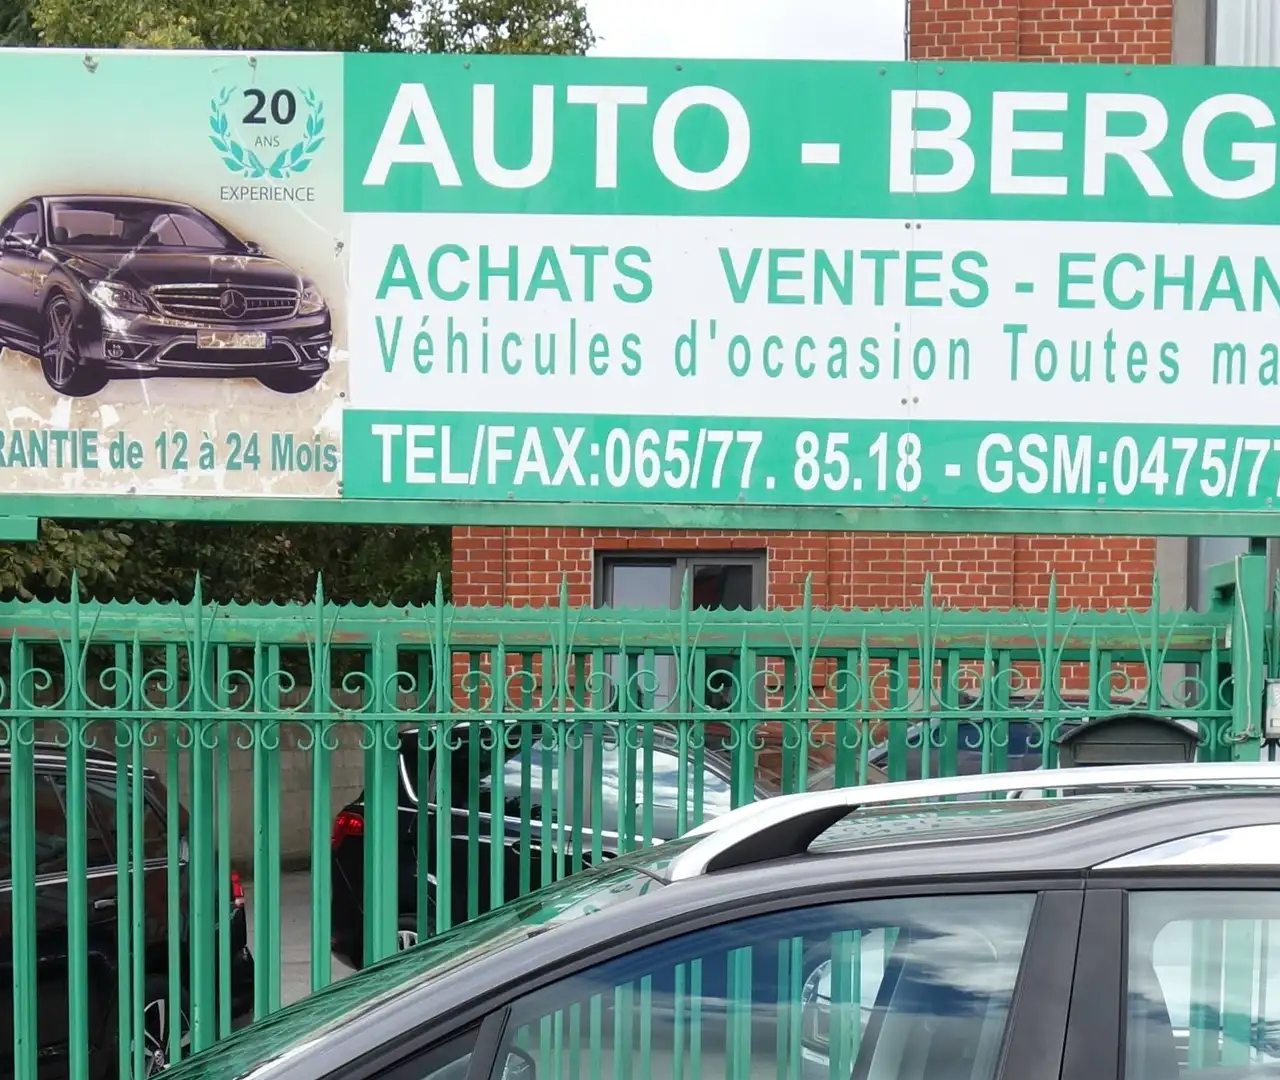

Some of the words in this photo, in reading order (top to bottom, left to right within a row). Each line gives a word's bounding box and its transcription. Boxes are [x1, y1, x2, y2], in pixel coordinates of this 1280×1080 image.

[242, 88, 297, 125] 20
[254, 136, 280, 148] ANS
[362, 81, 751, 192] AUTO
[220, 185, 316, 203] EXPERIENCE
[376, 244, 653, 303] ACHATS
[719, 248, 990, 308] VENTES
[376, 315, 642, 376] Véhicules
[674, 318, 970, 381] d'occasion
[1003, 323, 1180, 384] Toutes
[108, 430, 144, 470] de
[154, 431, 189, 471] 12
[198, 430, 219, 472] à
[223, 432, 262, 471] 24
[270, 432, 339, 474] Mois
